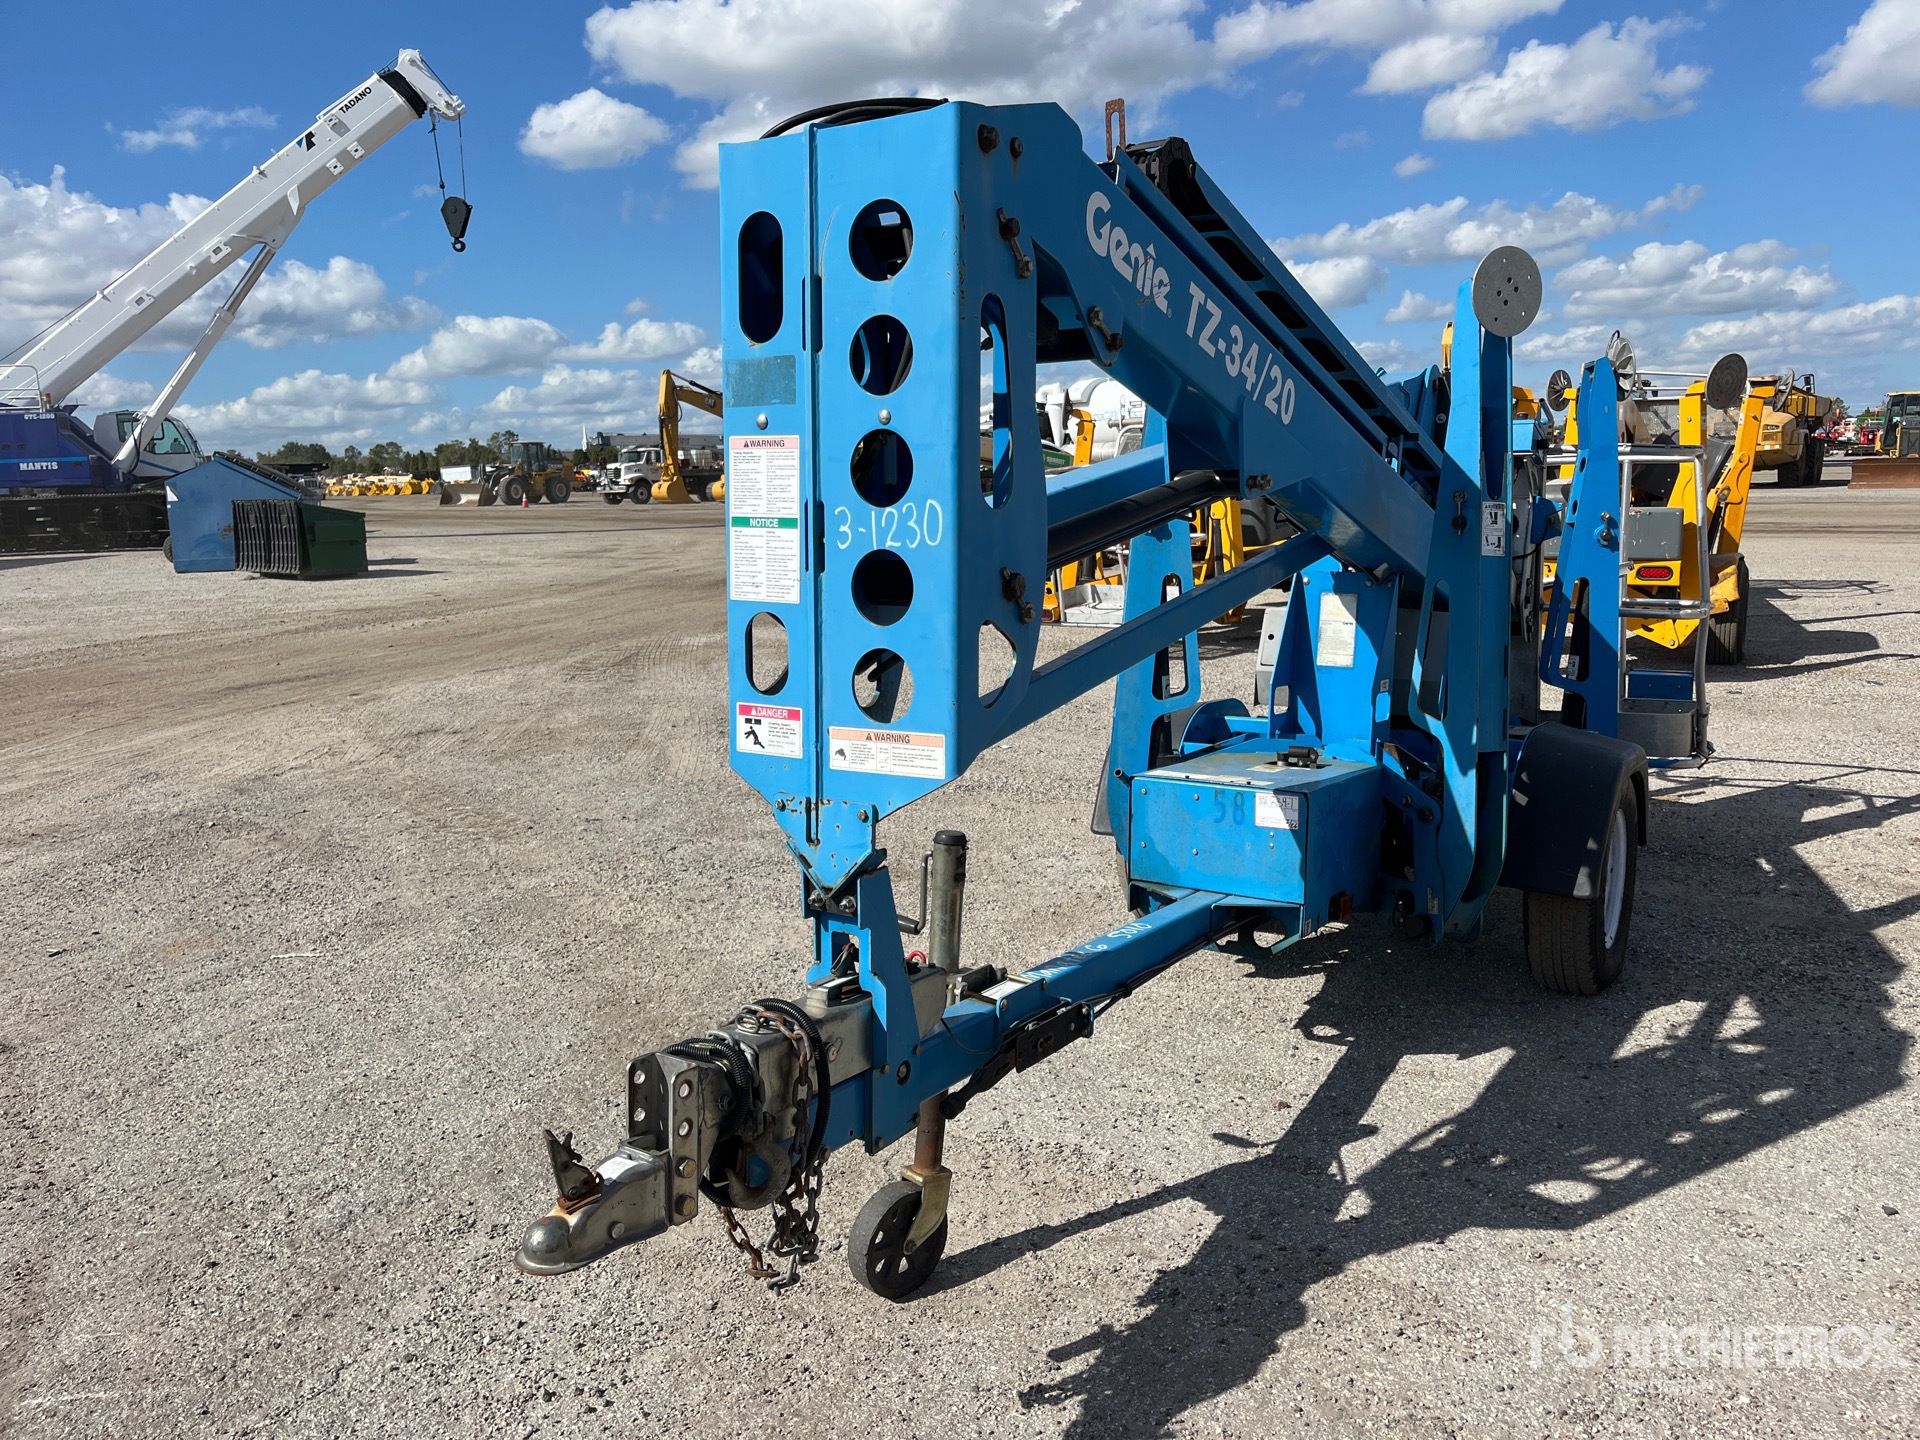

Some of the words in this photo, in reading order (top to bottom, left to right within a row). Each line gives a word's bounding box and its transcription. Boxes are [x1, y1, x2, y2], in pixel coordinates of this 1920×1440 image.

[339, 86, 372, 114] TADANO
[1085, 191, 1171, 315] Genie
[1186, 281, 1296, 425] TZ-34/20
[749, 439, 785, 448] WARNING
[19, 461, 58, 471] MANTIS
[749, 518, 779, 528] NOTICE
[834, 499, 943, 550] 3-1230
[757, 707, 788, 719] DANGER
[874, 733, 911, 744] WARNING
